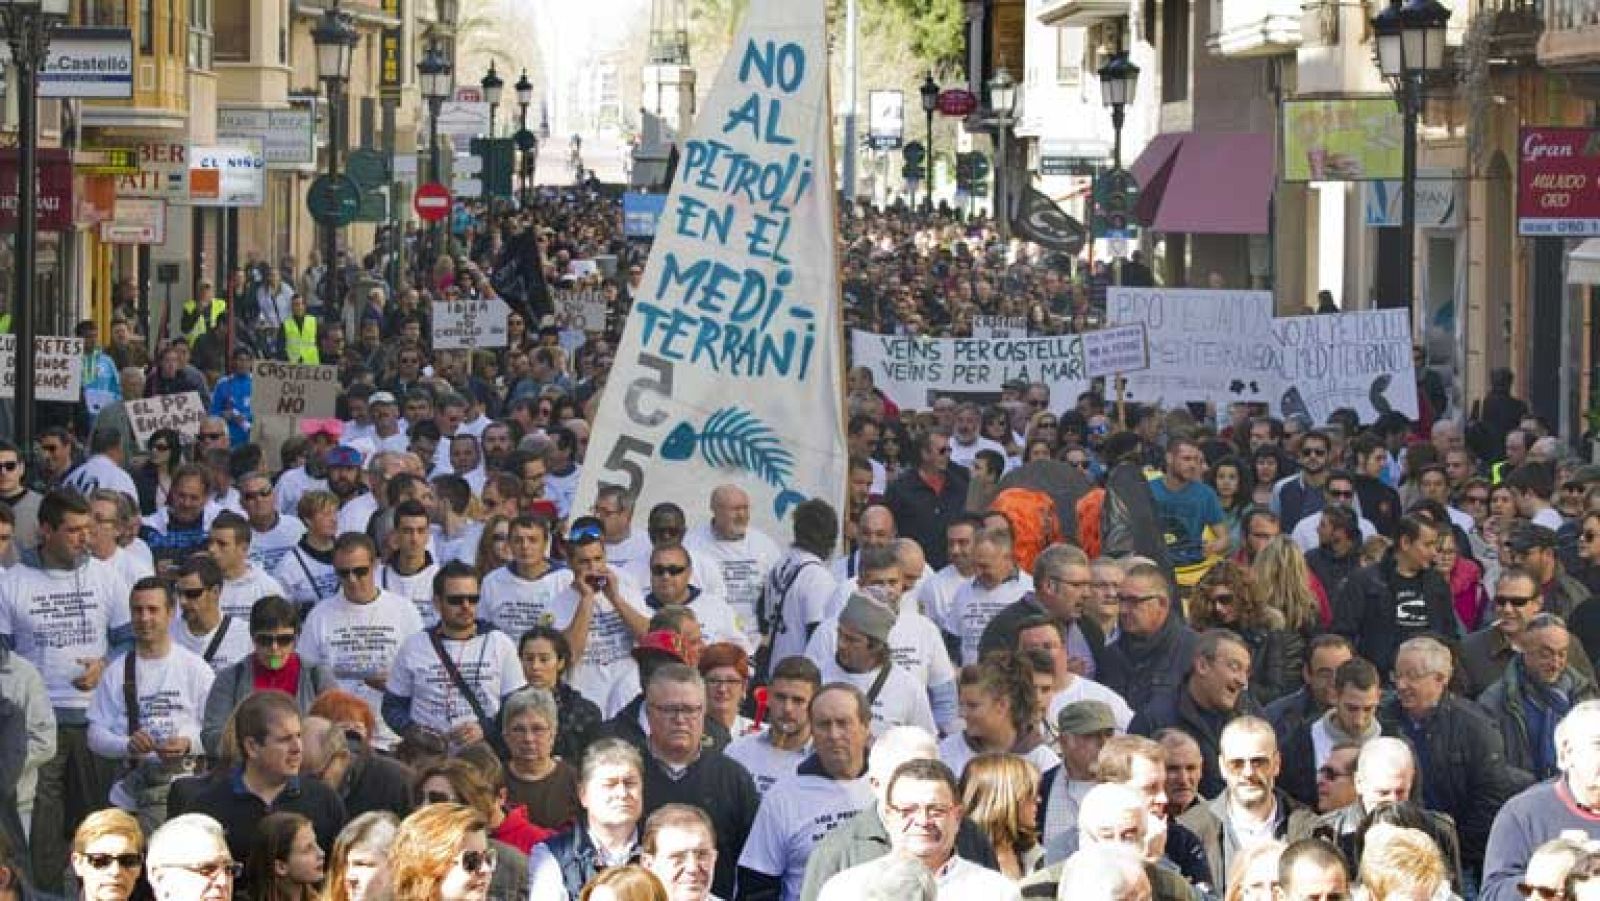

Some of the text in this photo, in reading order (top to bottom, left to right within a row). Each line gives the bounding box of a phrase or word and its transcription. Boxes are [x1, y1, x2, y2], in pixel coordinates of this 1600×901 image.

[738, 37, 806, 93] NO
[722, 92, 795, 145] AL
[1523, 133, 1572, 161] Gran
[676, 196, 791, 265] EN EL
[954, 340, 991, 361] PER
[952, 364, 990, 384] PER
[1003, 364, 1030, 382] LA
[1041, 359, 1082, 382] MAR
[276, 396, 305, 414] NO
